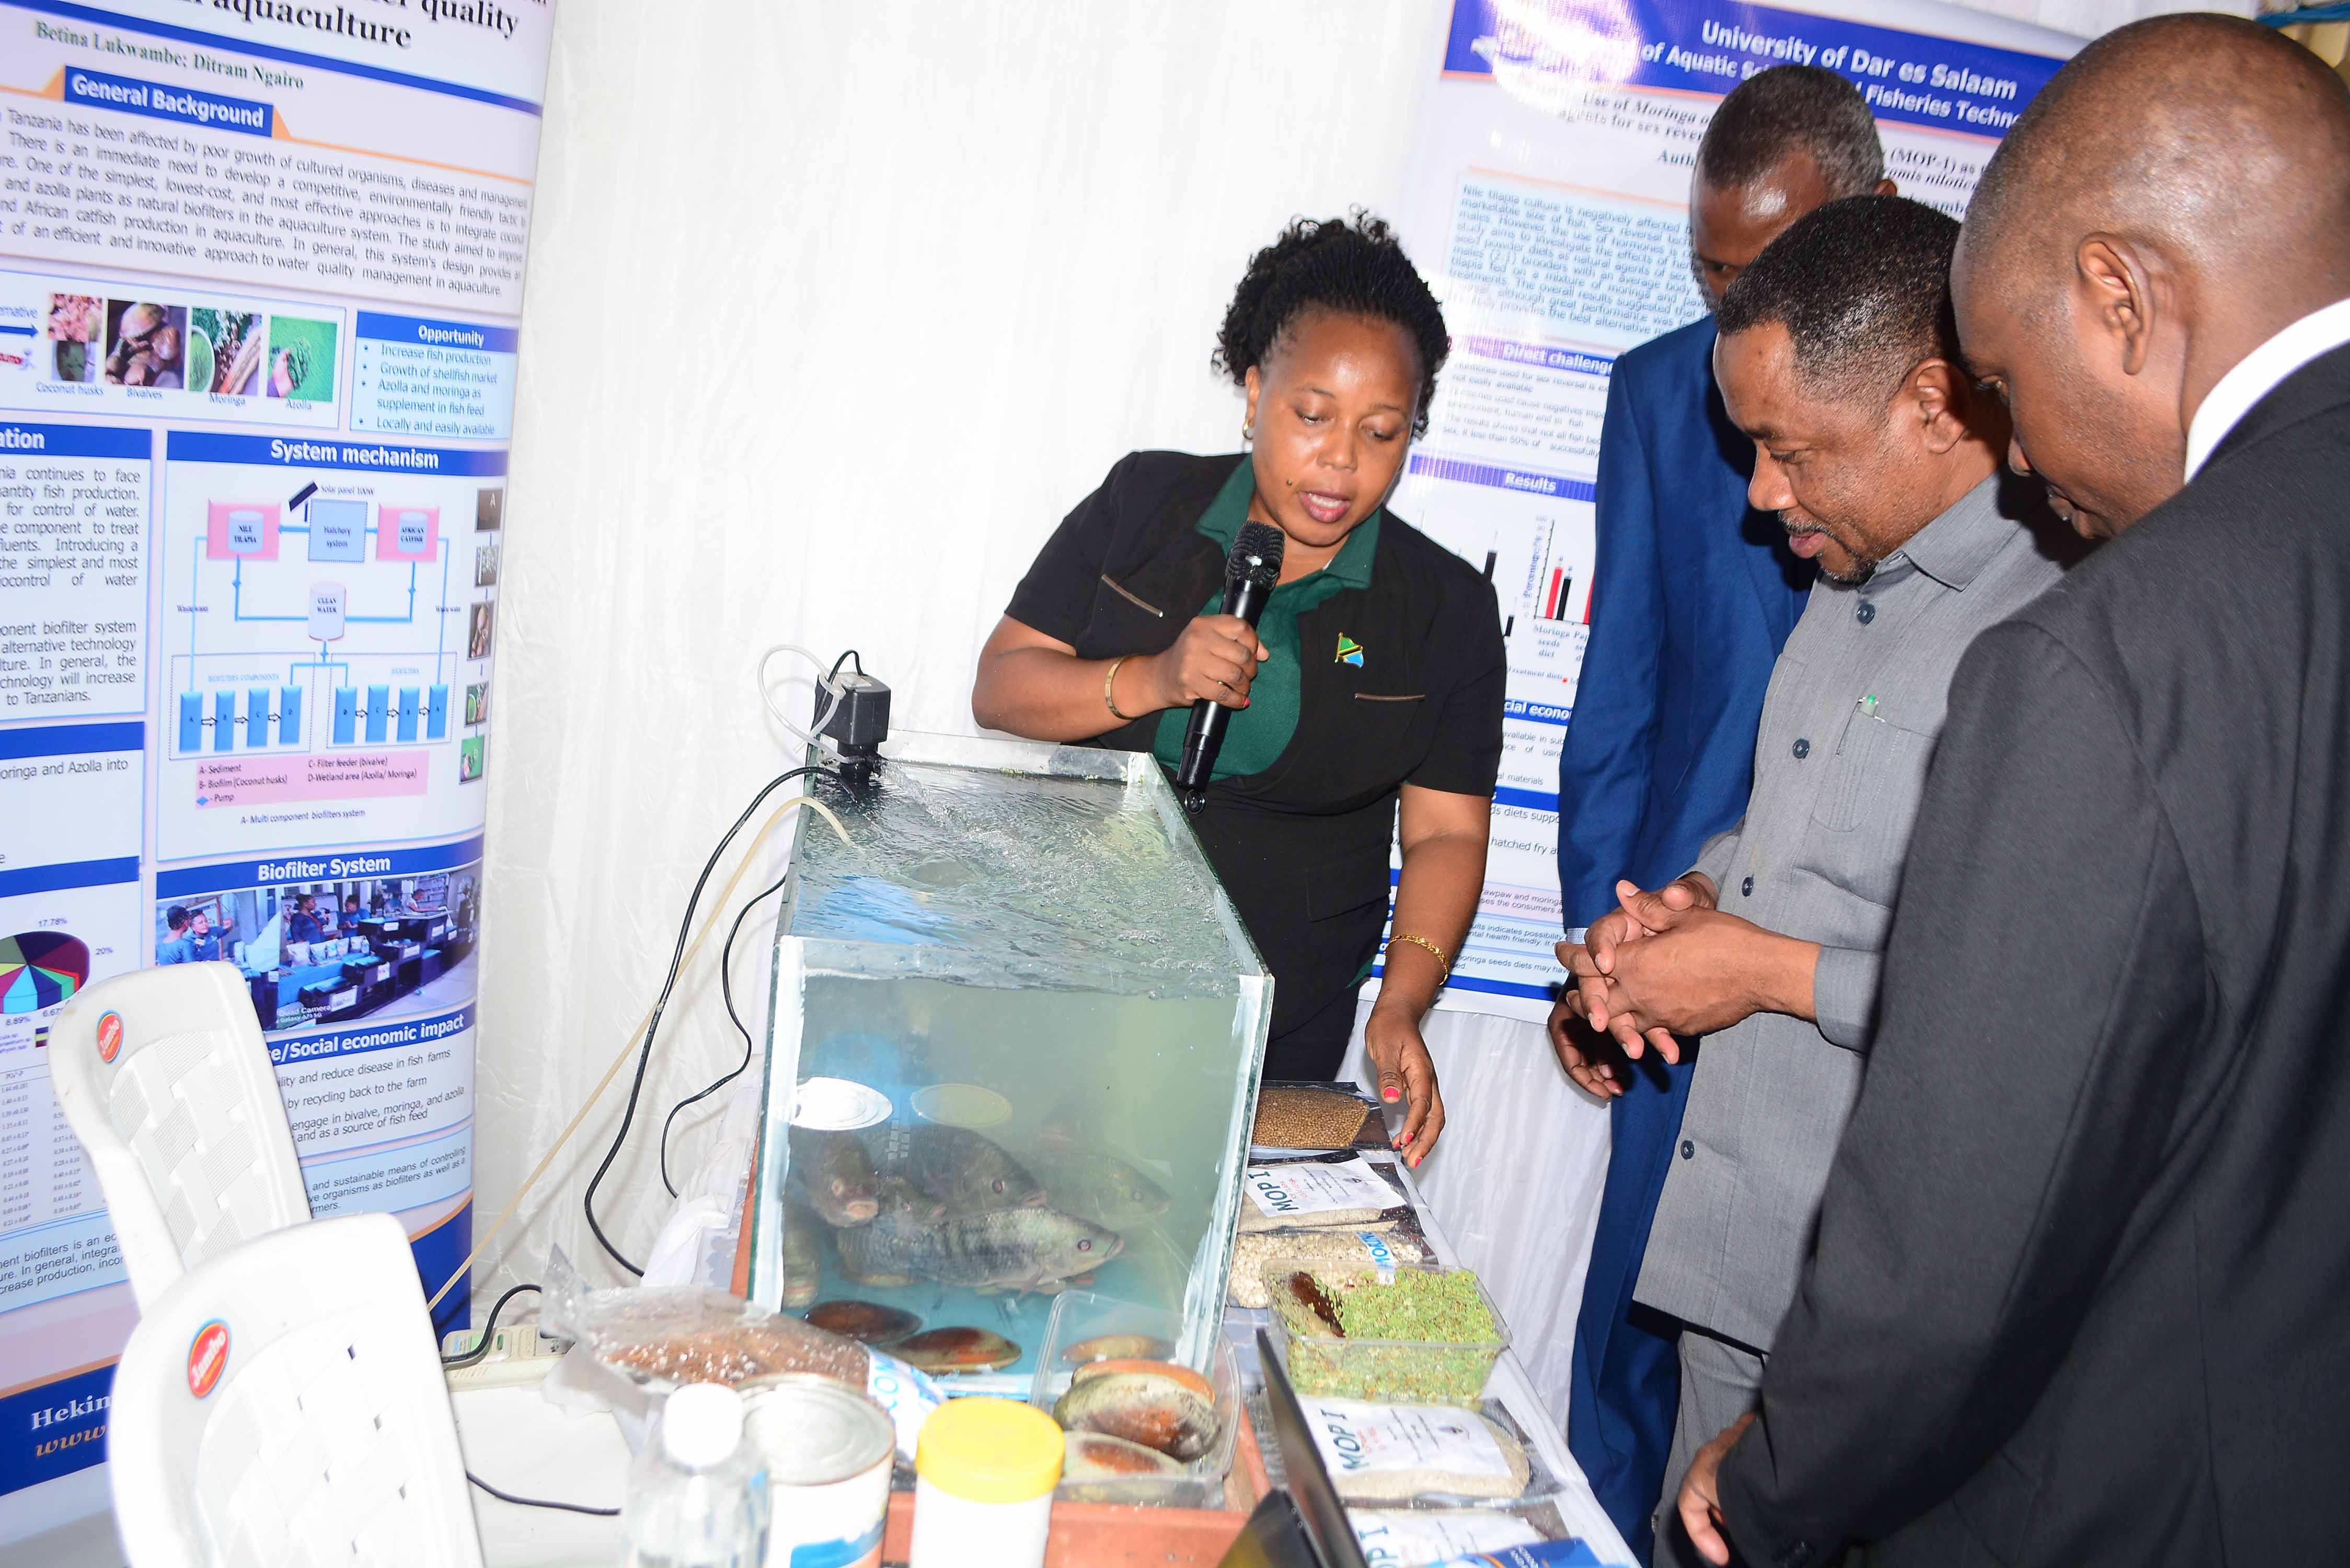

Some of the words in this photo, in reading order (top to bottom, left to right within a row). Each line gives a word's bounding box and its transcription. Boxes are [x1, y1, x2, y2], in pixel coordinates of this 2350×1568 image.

[421, 0, 519, 39] quality
[36, 19, 88, 47] Betina
[93, 33, 187, 66] Lukwambe;
[193, 53, 248, 79] Ditram
[254, 65, 304, 90] Ngairo
[1642, 41, 1663, 62] of
[1665, 45, 1738, 78] Aquatic
[1701, 20, 1817, 67] University
[1820, 45, 1848, 69] of
[1851, 50, 1894, 77] Dar
[1898, 62, 1926, 83] es
[1930, 63, 2017, 100] Salaam
[71, 73, 147, 107] General
[153, 87, 263, 129] Background
[1865, 83, 1951, 118] Fisheries
[1633, 100, 1696, 124] Moringa
[8, 109, 63, 132] Tanzania
[95, 124, 124, 141] been
[129, 130, 178, 152] affected
[297, 157, 343, 178] cultured
[349, 167, 406, 189] organisms,
[411, 177, 454, 196] diseases
[1637, 216, 1680, 233] affected
[418, 325, 484, 349] Opportunity
[382, 343, 424, 359] Increase
[427, 348, 443, 360] fish
[446, 351, 490, 366] production
[381, 362, 417, 376] Growth
[434, 368, 469, 382] shellfish
[378, 379, 408, 393] Azolla
[411, 384, 429, 395] and
[433, 385, 469, 399] moringa
[209, 393, 246, 407] Moringa
[377, 398, 434, 413] supplement
[449, 402, 464, 414] fish
[467, 404, 484, 416] feed
[377, 417, 410, 433] Locally
[414, 418, 431, 432] and
[436, 421, 460, 435] easily
[271, 439, 337, 463] System
[343, 446, 439, 469] mechanism
[26, 467, 85, 481] continues
[116, 469, 140, 482] face
[1506, 472, 1557, 491] Results
[44, 485, 64, 498] fish
[73, 486, 140, 501] production.
[7, 502, 24, 516] for
[33, 503, 74, 516] control
[14, 523, 81, 536] component
[111, 523, 139, 534] treat
[56, 539, 124, 554] Introducing
[28, 557, 77, 570] simplest
[82, 557, 103, 568] and
[109, 558, 138, 568] most
[105, 576, 136, 586] water
[43, 621, 88, 635] biofilter
[95, 621, 136, 635] system
[1534, 625, 1570, 637] Moringa
[2, 640, 65, 653] alternative
[71, 637, 136, 652] technology
[60, 654, 108, 671] general,
[118, 654, 136, 666] the
[60, 672, 79, 685] will
[86, 672, 135, 684] increase
[24, 690, 90, 704] Tanzanians.
[42, 762, 63, 775] and
[68, 759, 102, 773] Azolla
[107, 759, 128, 770] into
[209, 765, 241, 773] Sediment
[1508, 774, 1543, 786] materials
[214, 794, 234, 802] Pump
[250, 815, 269, 823] Multi
[270, 813, 308, 822] component
[1504, 806, 1528, 819] diets
[1491, 837, 1531, 851] hatched
[258, 861, 326, 881] Biofilter
[330, 857, 390, 877] System
[1512, 902, 1555, 913] consumers
[1486, 932, 1510, 941] health
[1513, 936, 1541, 946] friendly.
[1488, 925, 1522, 935] indicates
[1525, 930, 1563, 941] possibility
[1489, 958, 1511, 967] seeds
[1514, 961, 1532, 970] diets
[1535, 964, 1551, 973] may
[270, 1037, 339, 1063] e/Social
[342, 1027, 417, 1049] economic
[421, 1013, 464, 1038] impact
[299, 1073, 317, 1083] and
[322, 1068, 353, 1081] reduce
[358, 1062, 393, 1076] disease
[408, 1054, 423, 1066] fish
[428, 1050, 451, 1063] farms
[287, 1099, 298, 1109] by
[304, 1091, 345, 1107] recycling
[350, 1086, 371, 1098] back
[387, 1080, 402, 1091] the
[407, 1076, 427, 1088] farm
[292, 1116, 328, 1133] engage
[345, 1108, 380, 1123] bivalve,
[384, 1099, 423, 1116] moringa,
[427, 1094, 442, 1105] and
[297, 1131, 315, 1142] and
[343, 1121, 373, 1134] source
[390, 1114, 405, 1125] fish
[409, 1109, 428, 1120] feed
[313, 1182, 329, 1191] and
[334, 1169, 389, 1186] sustainable
[388, 1162, 416, 1176] means
[431, 1147, 466, 1166] controlling
[323, 1184, 369, 1200] organisms
[386, 1173, 421, 1187] biofilters
[1257, 1182, 1299, 1211] MOP
[25, 1244, 68, 1262] biofilters
[35, 1255, 77, 1274] general,
[37, 1263, 95, 1286] production,
[37, 1425, 106, 1457] www
[1328, 1424, 1369, 1469] MOP
